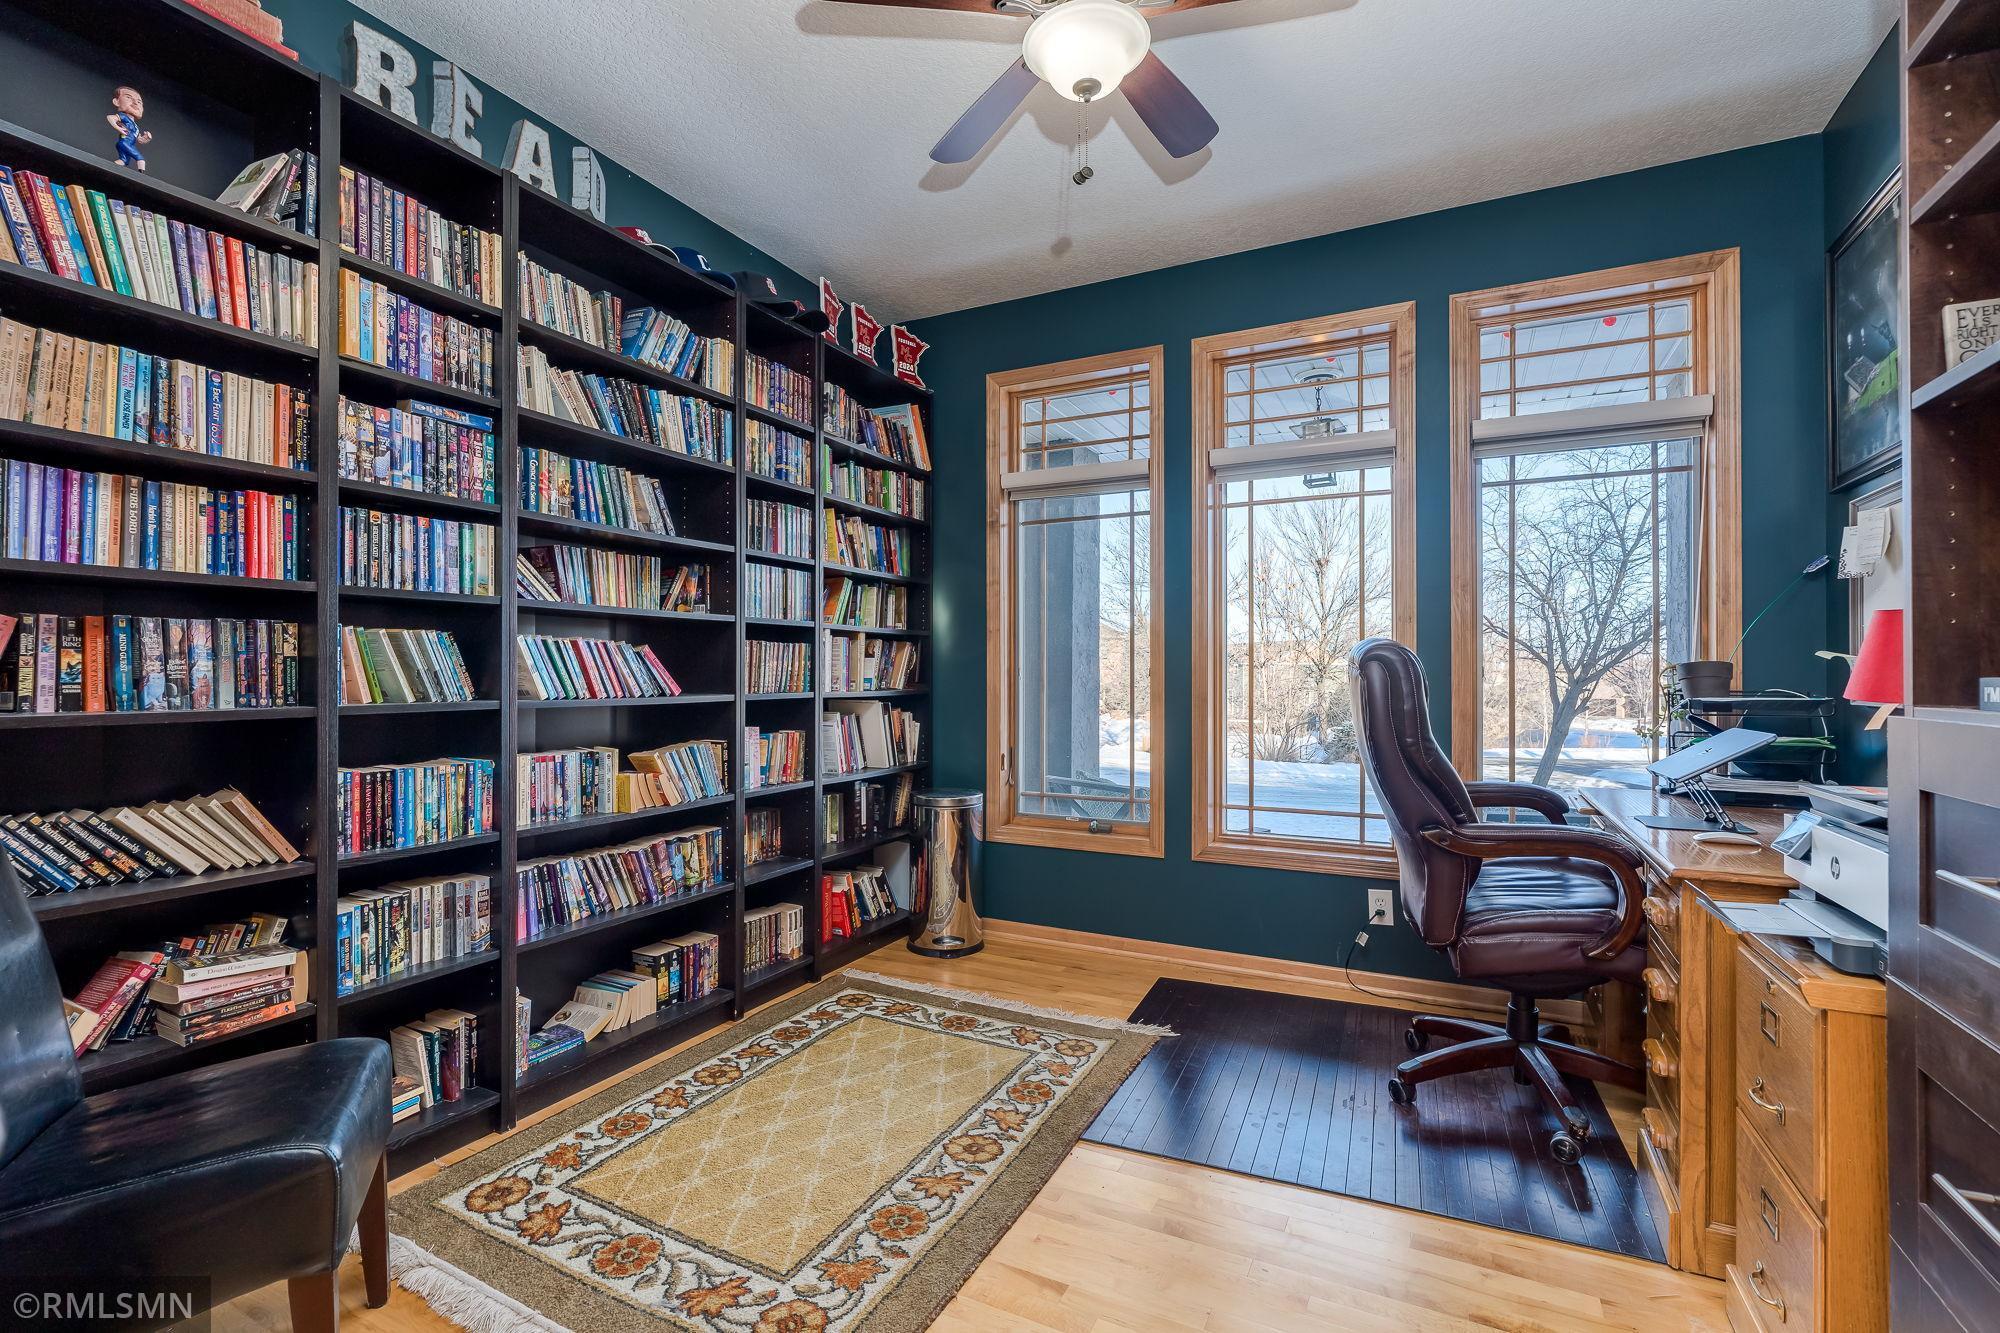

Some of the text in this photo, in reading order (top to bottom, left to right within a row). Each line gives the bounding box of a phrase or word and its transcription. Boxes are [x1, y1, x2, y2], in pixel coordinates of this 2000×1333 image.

[342, 20, 606, 223] READ
[37, 192, 59, 235] EDDINGS
[359, 213, 368, 245] PROPHECY
[384, 217, 392, 256] TALISMAN
[108, 239, 117, 252] SON
[1973, 317, 1991, 327] IS
[859, 343, 871, 354] 2022
[898, 338, 916, 347] FOOTBALL
[899, 362, 913, 371] 2024
[212, 388, 220, 401] ERIC
[211, 423, 224, 444] 1632
[129, 510, 137, 534] LORD
[16, 826, 69, 866] Barbara Hambly
[41, 822, 91, 862] Barbara Hambly
[98, 821, 141, 854] Barbara Hambly
